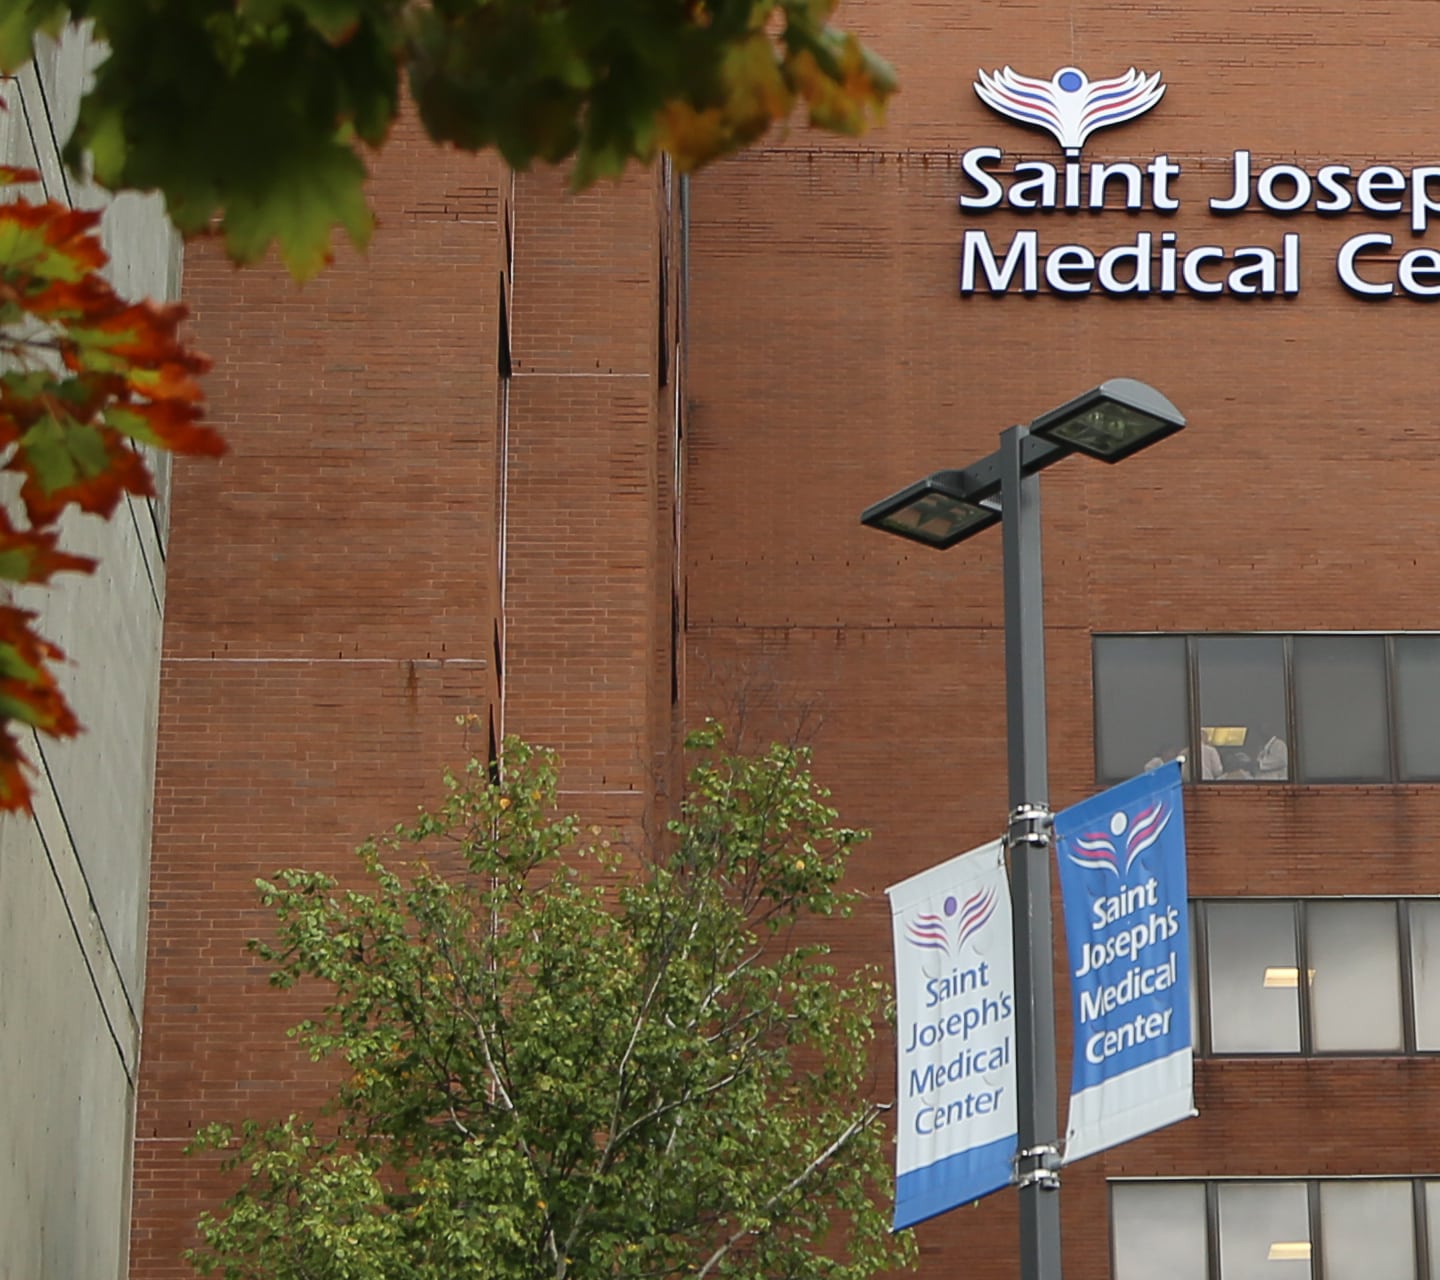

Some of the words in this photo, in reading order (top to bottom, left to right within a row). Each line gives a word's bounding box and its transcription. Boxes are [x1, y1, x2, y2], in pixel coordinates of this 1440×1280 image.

[959, 146, 1180, 214] Saint
[959, 230, 1300, 300] Medical
[1092, 877, 1158, 930] Saint
[1075, 905, 1179, 977] Joseph's
[926, 961, 989, 1008] Saint
[1080, 951, 1177, 1023] Medical
[905, 991, 1012, 1053] Joseph's
[1085, 1008, 1173, 1064] Center
[909, 1036, 1009, 1097] Medical
[915, 1087, 1004, 1135] Center
